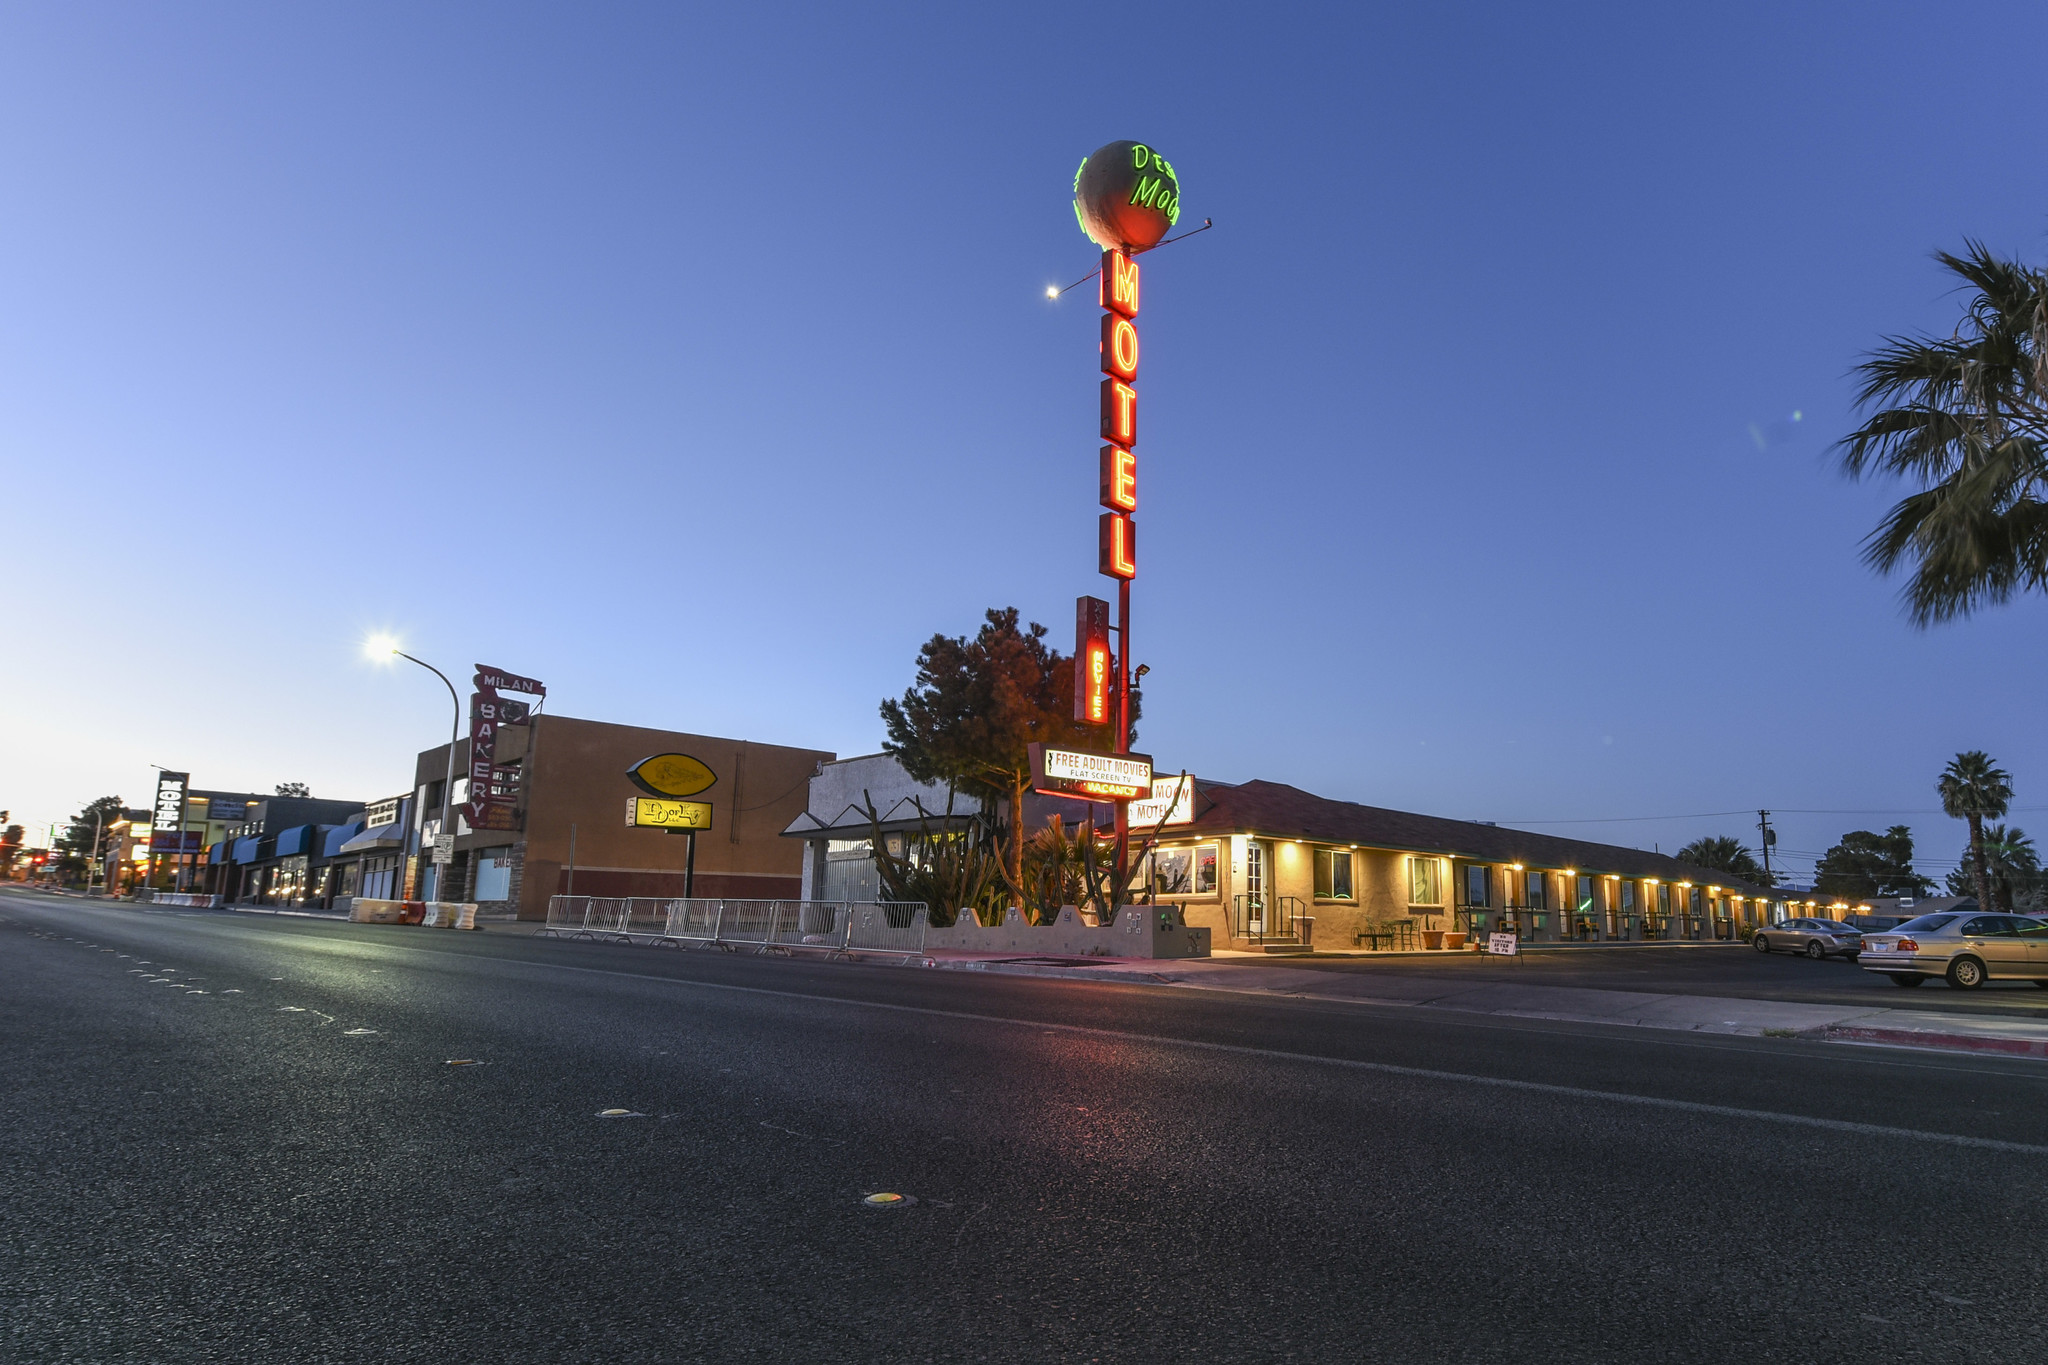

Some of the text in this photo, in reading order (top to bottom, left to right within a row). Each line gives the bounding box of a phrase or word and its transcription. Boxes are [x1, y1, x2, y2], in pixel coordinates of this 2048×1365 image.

[1115, 251, 1139, 574] MOTEL
[484, 674, 534, 692] MILAN
[1092, 650, 1104, 718] MOVIES
[471, 703, 496, 818] BAKERY
[1056, 751, 1149, 778] FREE ADULT MOVIES
[1070, 769, 1132, 783] FLAT SCREEN TV
[1086, 781, 1138, 796] VACANCY
[154, 780, 184, 831] MOTEL
[1200, 855, 1217, 866] OPE
